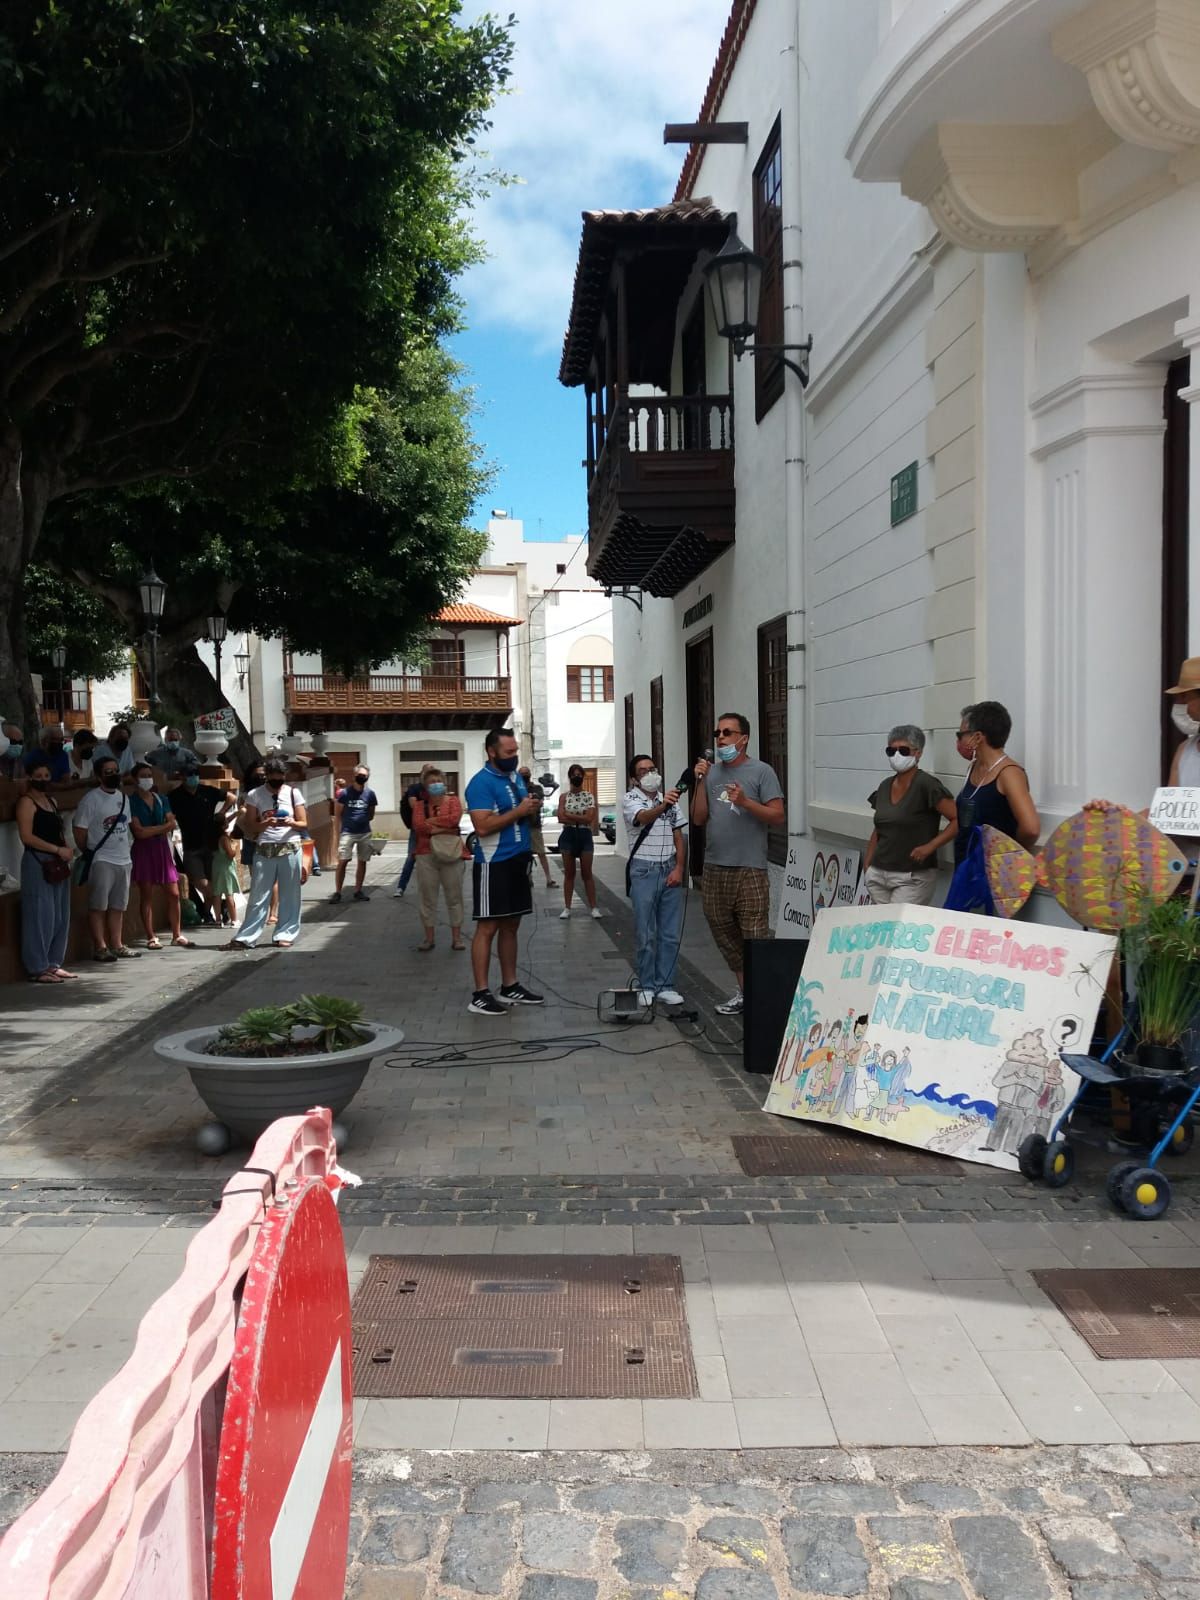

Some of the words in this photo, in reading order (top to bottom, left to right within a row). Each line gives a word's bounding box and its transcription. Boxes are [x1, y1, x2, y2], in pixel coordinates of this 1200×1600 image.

[1158, 801, 1199, 819] PODER
[827, 921, 935, 954] NOSOTROS
[841, 953, 865, 980] LA
[868, 955, 1026, 1012] DEPURADORA
[871, 991, 1003, 1047] NATURAL
